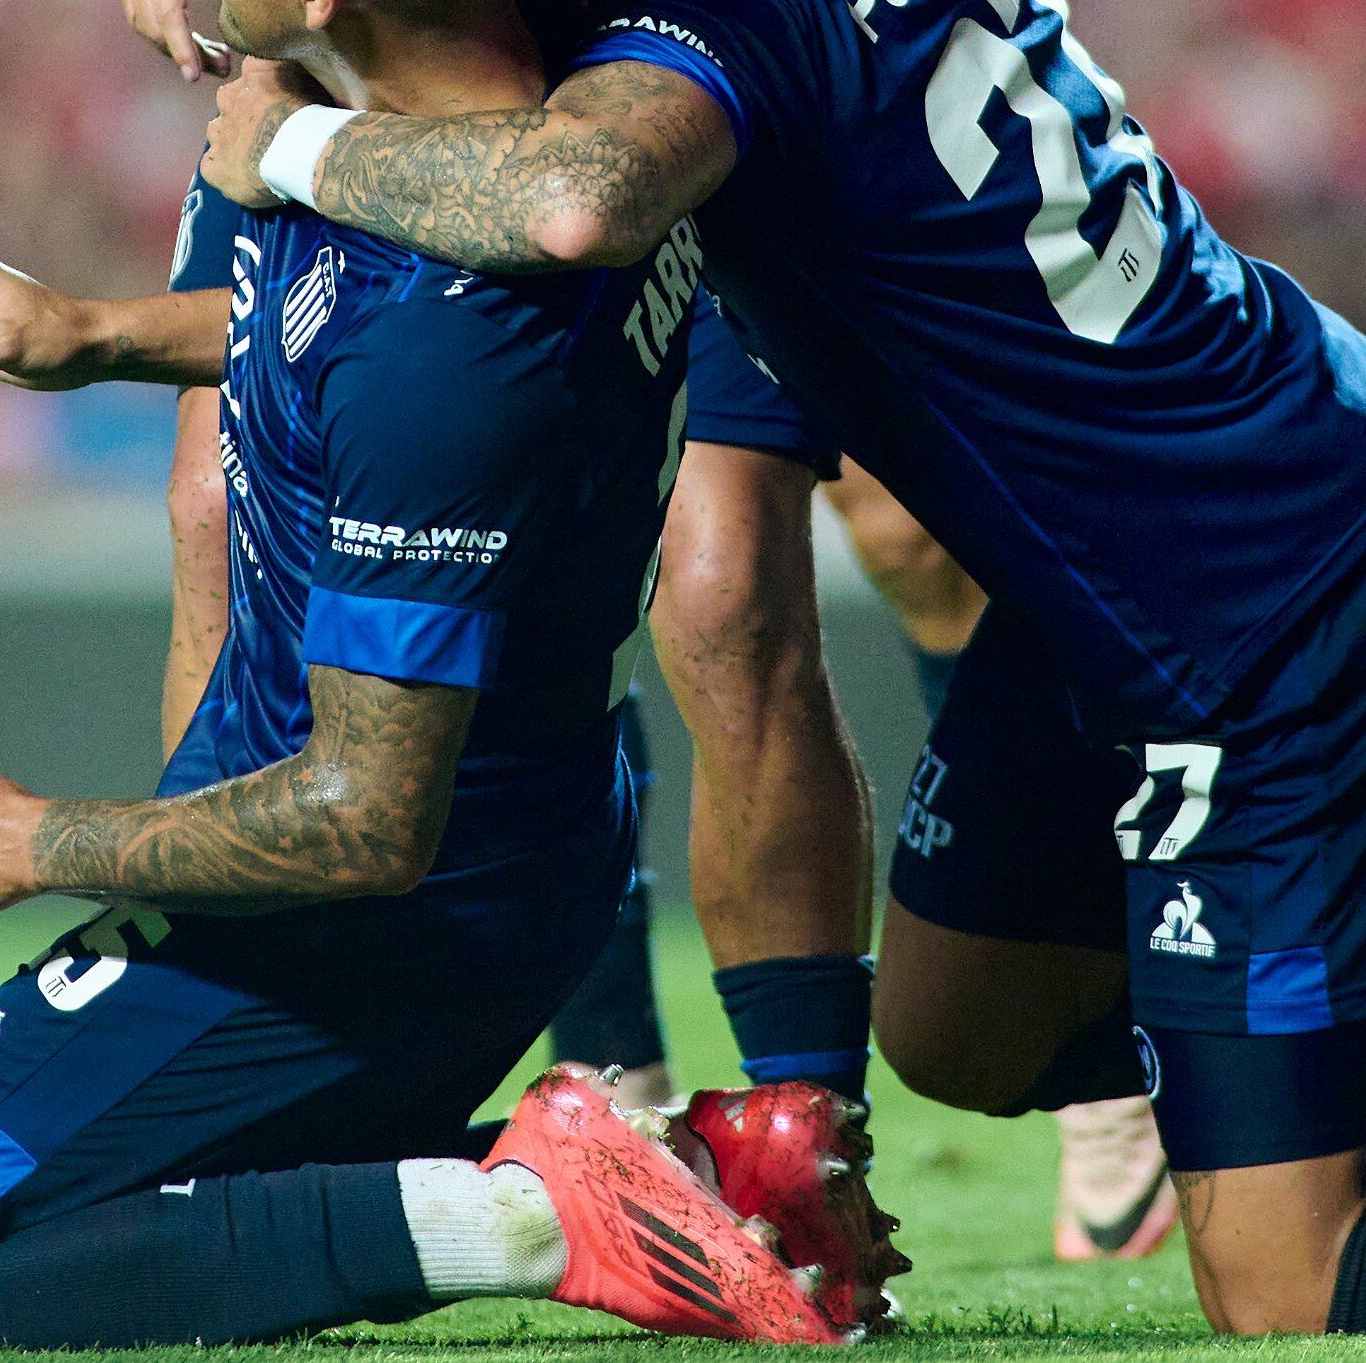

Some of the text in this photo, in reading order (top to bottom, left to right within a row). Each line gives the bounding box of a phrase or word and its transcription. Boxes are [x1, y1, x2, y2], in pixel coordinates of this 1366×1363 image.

[622, 212, 703, 378] TARR
[329, 515, 508, 550] TERRAWIND
[332, 538, 383, 560] GLOBAL
[1150, 936, 1161, 950] LE
[1178, 941, 1216, 958] SPORTIF
